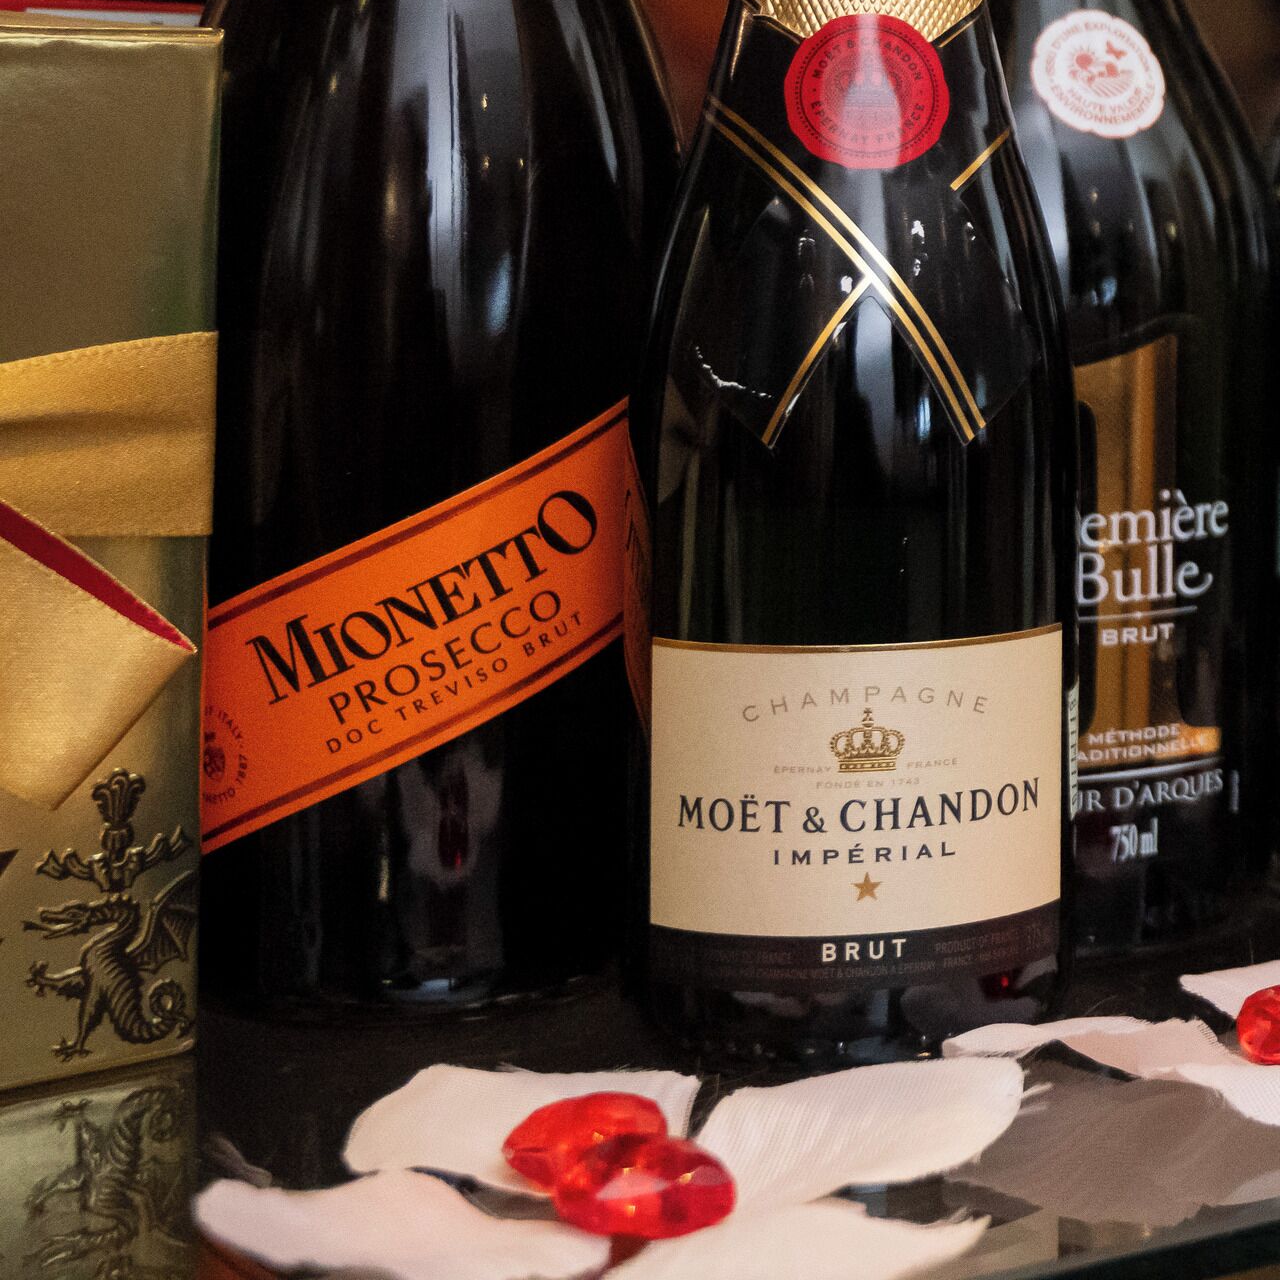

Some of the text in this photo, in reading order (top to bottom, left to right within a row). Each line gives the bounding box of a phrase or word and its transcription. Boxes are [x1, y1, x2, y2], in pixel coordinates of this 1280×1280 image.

[1079, 488, 1230, 548] emière
[1076, 542, 1214, 605] Bulle
[245, 489, 598, 705] MIONETTO
[1102, 622, 1175, 647] BRUT
[328, 589, 562, 726] PROSECCO
[326, 611, 582, 755] DOC TREVISO BRUT
[742, 686, 989, 722] CHAMPAGNE
[1077, 735, 1208, 762] ADITIONNELLE
[1087, 722, 1181, 746] MÉTHODE
[907, 757, 959, 770] FRANCE
[678, 793, 791, 833] MOËT
[802, 806, 828, 834] &
[839, 777, 1040, 833] CHANDON
[1112, 768, 1225, 810] D'ARQUES
[773, 841, 957, 867] IMPÉRIAL
[821, 938, 908, 964] BRUT
